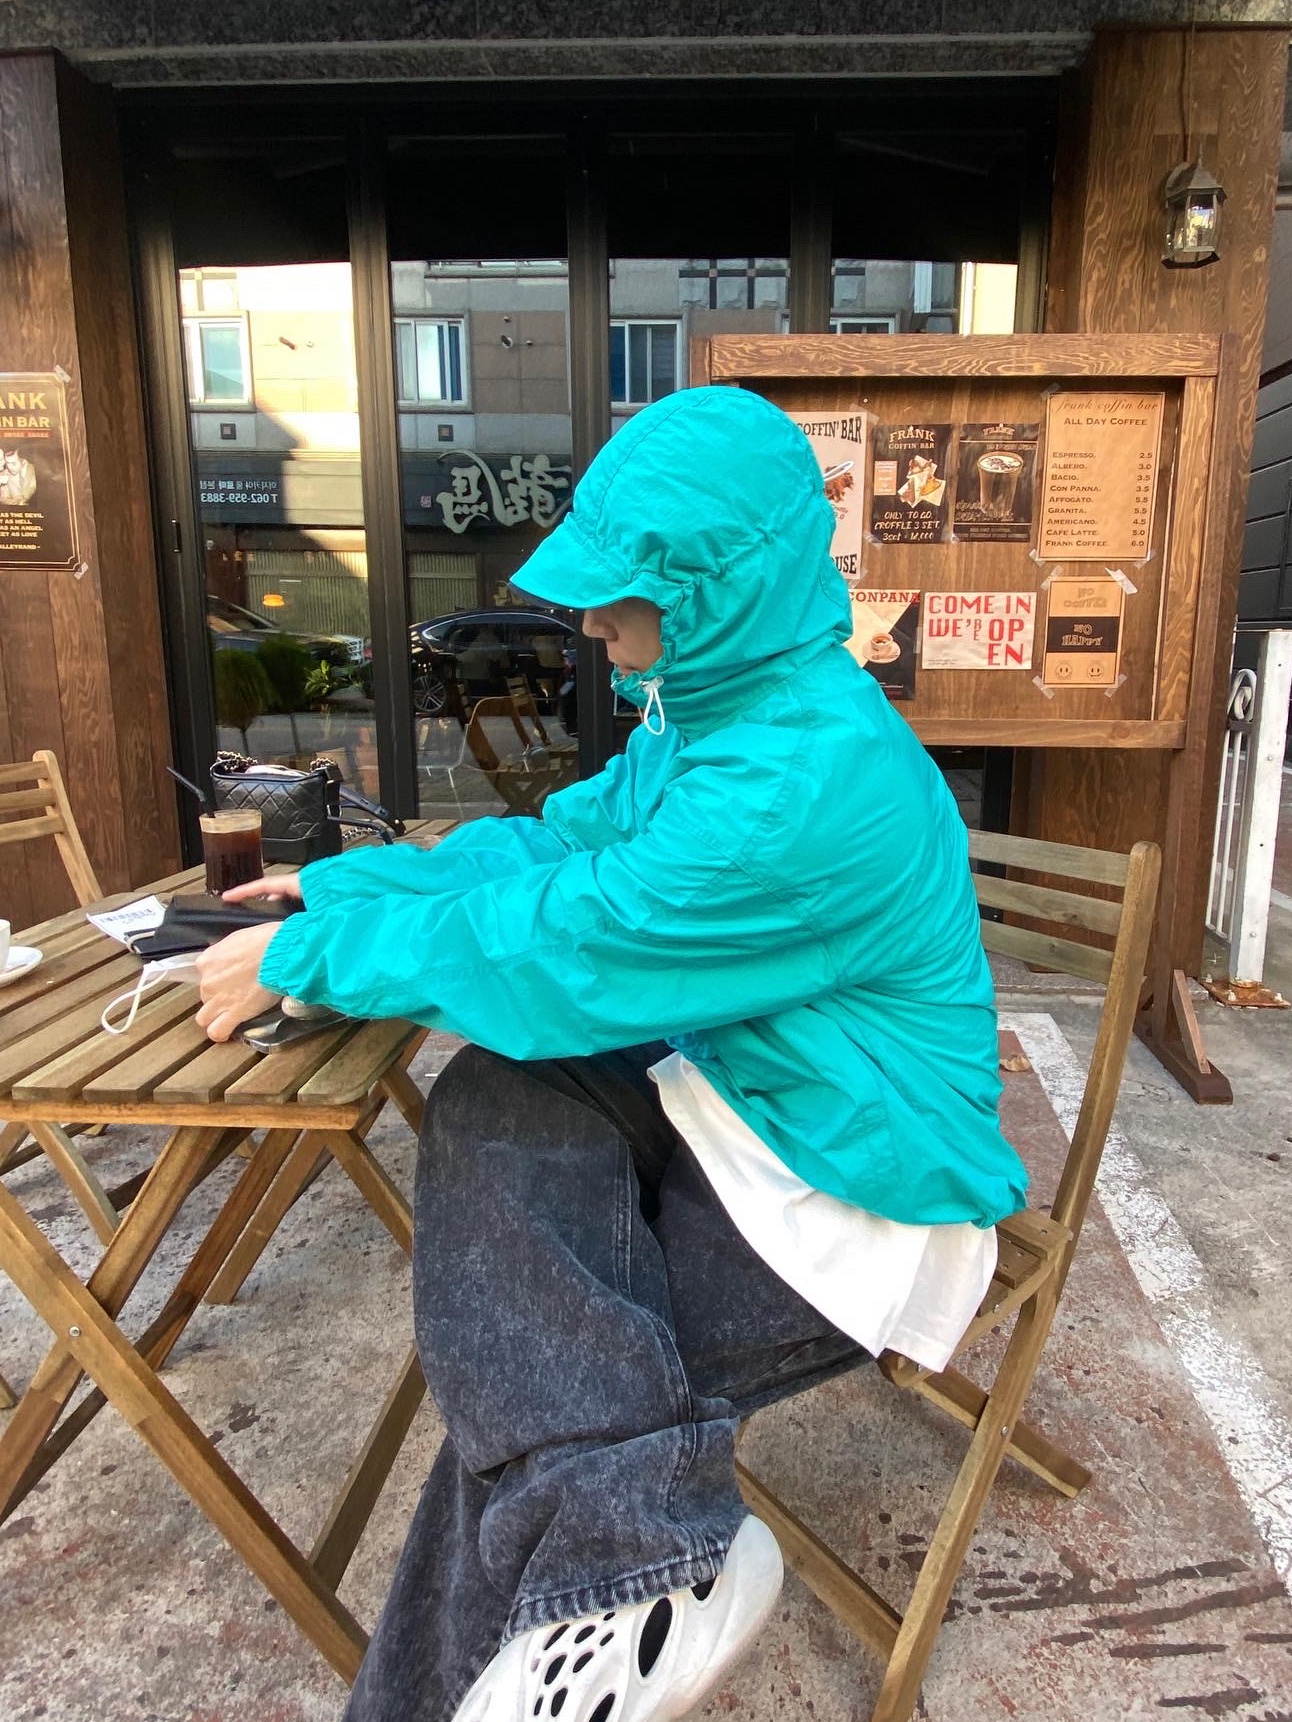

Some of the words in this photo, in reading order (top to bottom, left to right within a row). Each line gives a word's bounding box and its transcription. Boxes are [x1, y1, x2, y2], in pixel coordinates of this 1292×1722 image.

[1096, 398, 1132, 413] coffin
[1136, 399, 1159, 410] bar
[17, 416, 50, 428] BAR
[1063, 417, 1083, 425] ALL
[1086, 417, 1107, 425] DAY
[1110, 417, 1148, 426] COFFEE
[841, 416, 862, 444] BAR
[889, 427, 936, 443] FRANK
[920, 442, 935, 450] BAR
[1139, 451, 1153, 459] 2.5
[907, 511, 919, 519] TO
[874, 521, 912, 530] CROFFLE
[913, 521, 921, 530] 3
[832, 553, 858, 575] USE
[929, 595, 995, 614] COME
[1005, 595, 1031, 614] IN
[1073, 623, 1093, 636] NO
[1062, 634, 1104, 646] HAPPY
